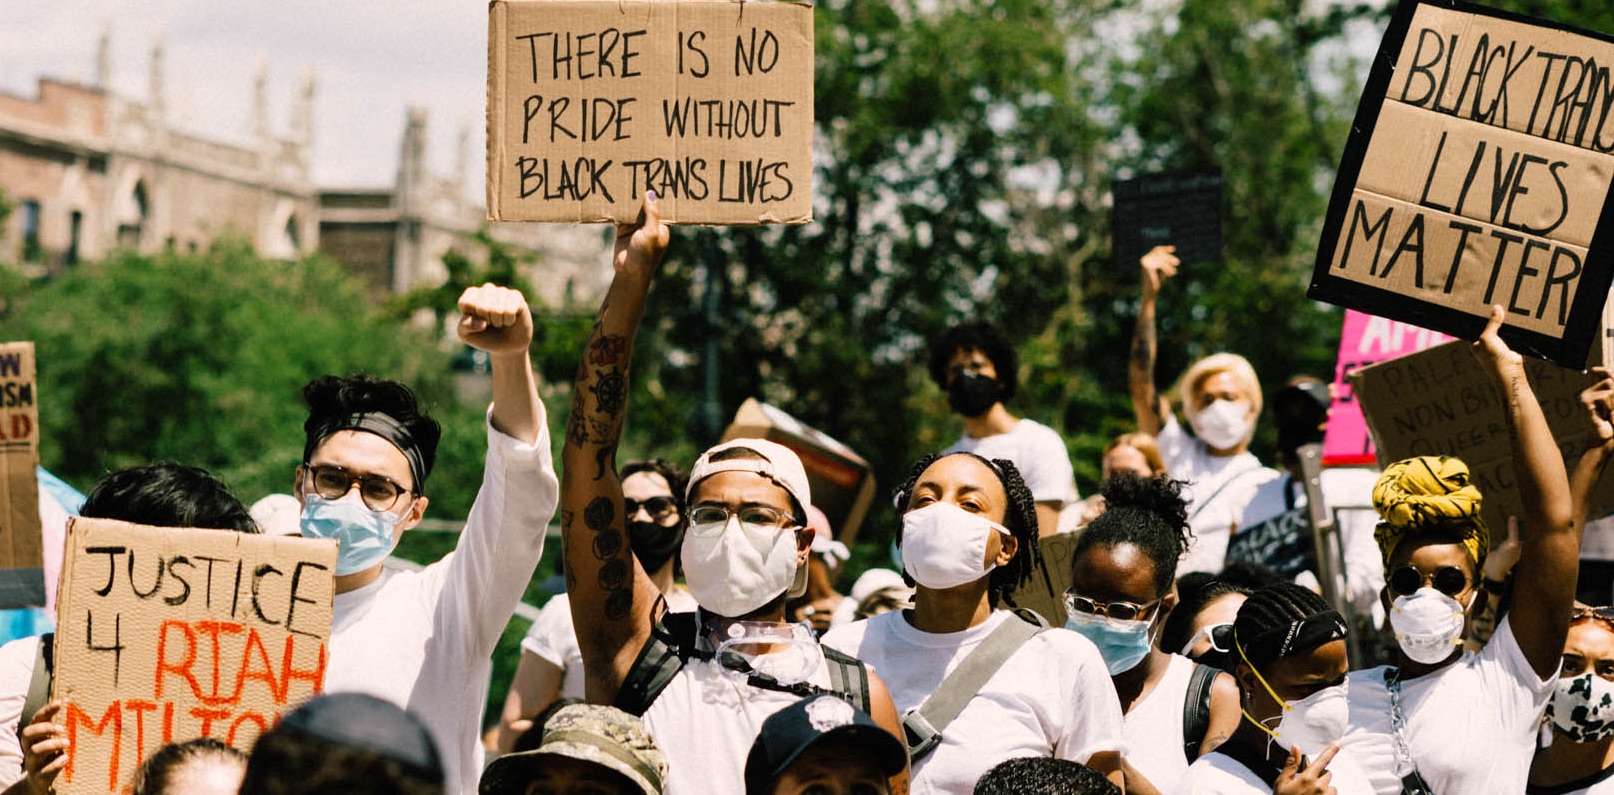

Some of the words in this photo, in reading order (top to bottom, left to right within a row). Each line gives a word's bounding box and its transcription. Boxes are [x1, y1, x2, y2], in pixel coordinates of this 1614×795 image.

[515, 28, 647, 83] THERE
[678, 30, 709, 78] IS
[735, 27, 779, 77] NO
[1401, 28, 1535, 129] BLACK
[523, 95, 638, 144] PRIDE
[663, 96, 796, 139] WITHOUT
[515, 156, 615, 203] BLACK
[622, 156, 709, 200] TRANS
[718, 158, 793, 204] LIVES
[1420, 131, 1569, 236] LIVES
[1339, 200, 1582, 326] MATTER
[85, 546, 328, 639] JUSTICE
[87, 610, 126, 688] 4
[154, 620, 326, 707] RIAH
